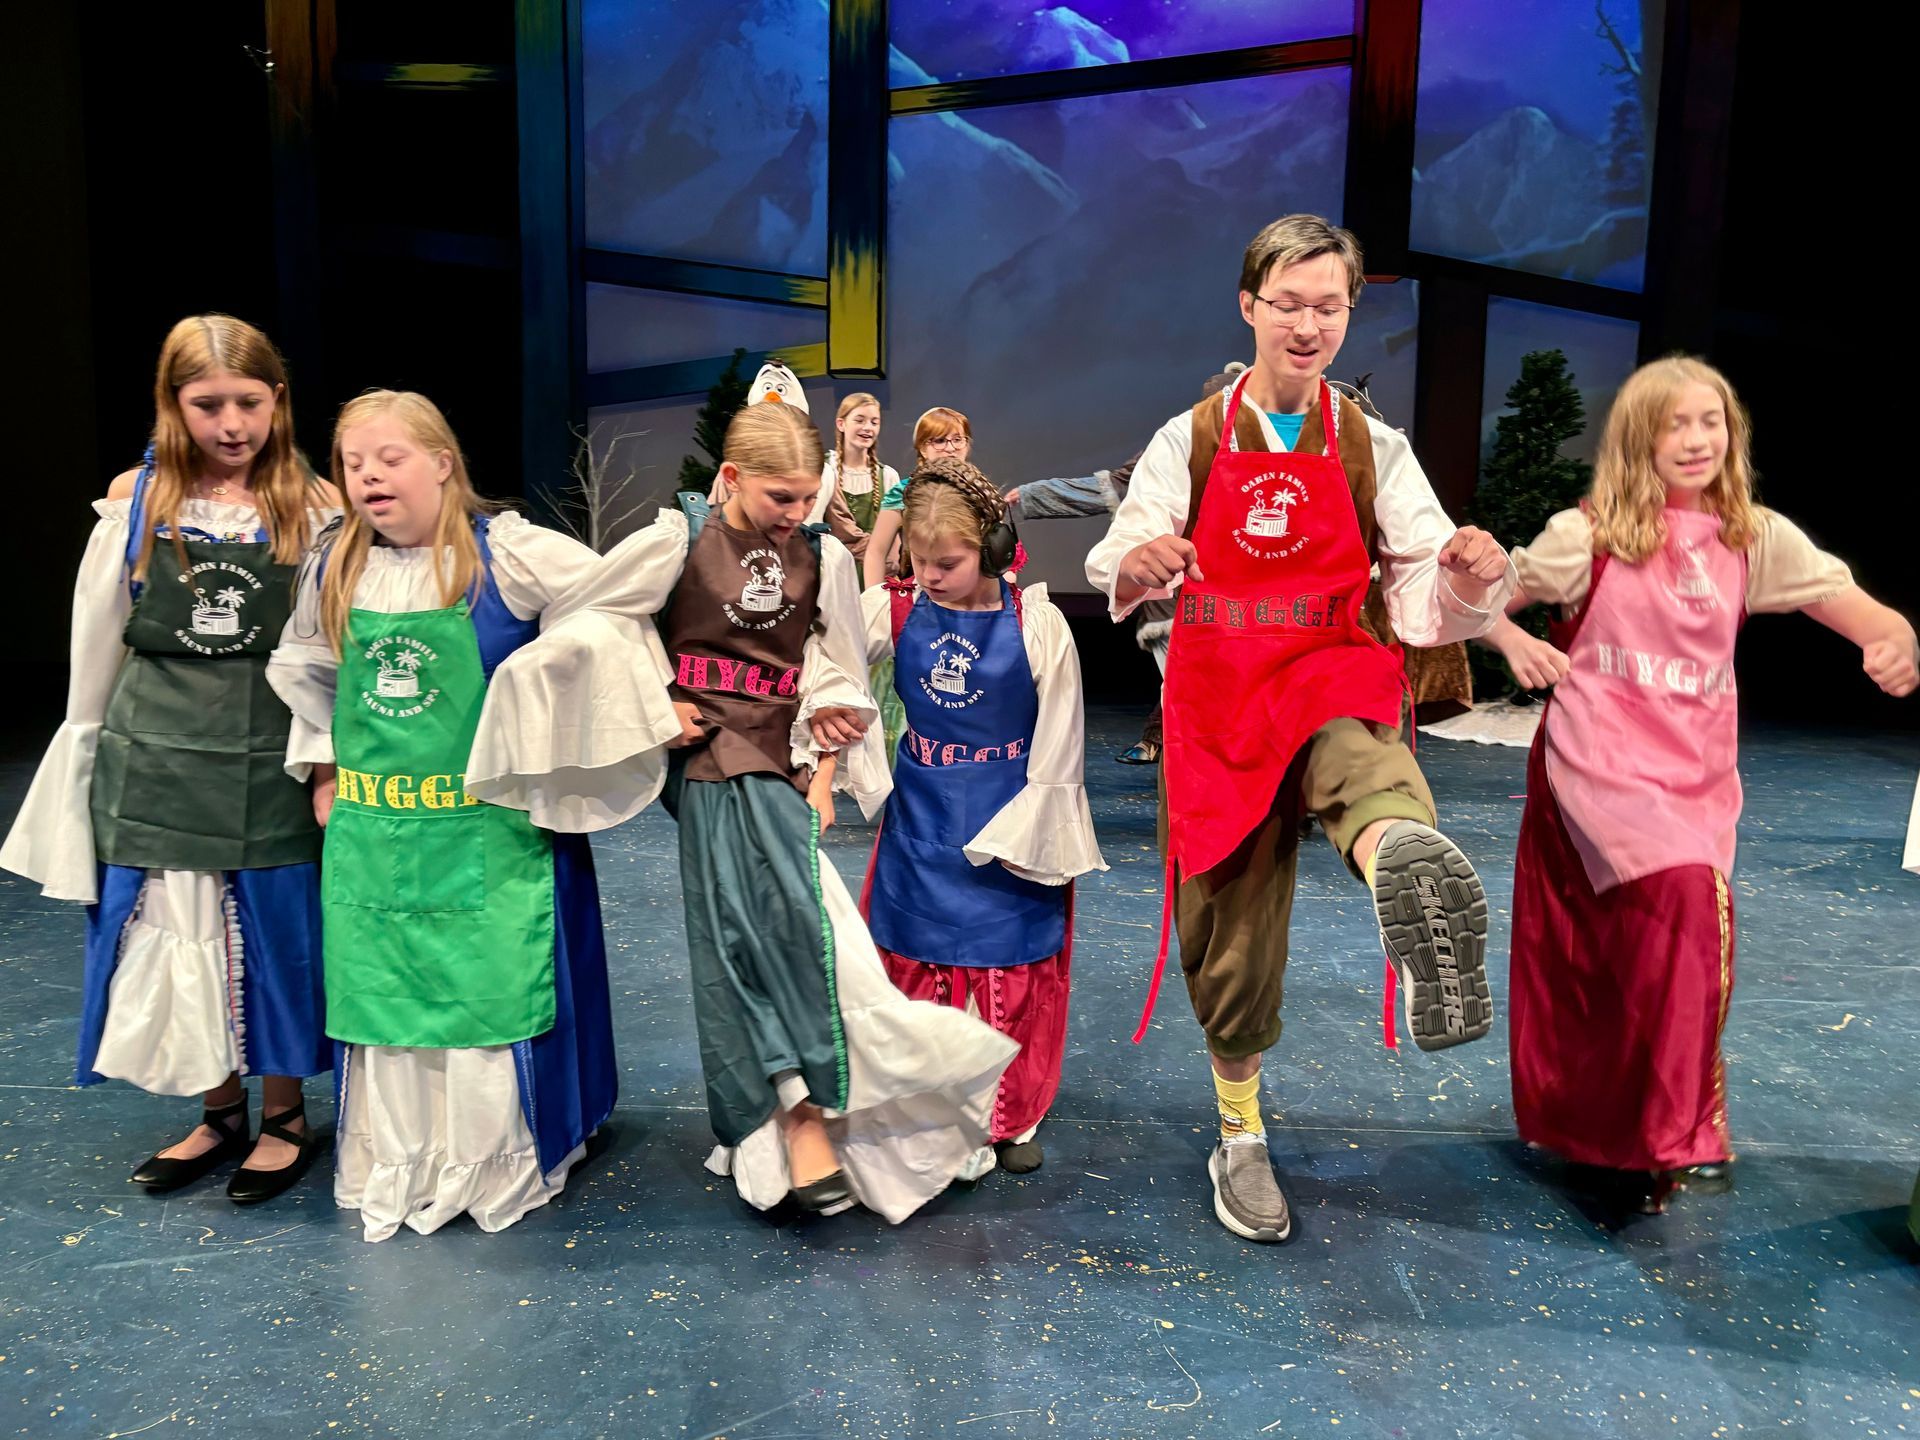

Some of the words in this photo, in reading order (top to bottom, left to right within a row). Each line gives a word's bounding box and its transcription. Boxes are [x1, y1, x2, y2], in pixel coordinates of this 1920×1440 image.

[1241, 472, 1275, 493] OAKEN
[1279, 472, 1309, 502] FAMILY
[1264, 550, 1287, 559] AND
[1291, 536, 1310, 553] SPA
[220, 562, 263, 589] FAMILY
[753, 620, 776, 629] AND
[778, 604, 796, 620] SPA
[174, 629, 212, 655] SAUNA
[217, 643, 243, 653] AND
[243, 626, 262, 644] SPA
[364, 637, 393, 659] OAKEN
[396, 636, 438, 661] FAMILY
[952, 633, 981, 659] FAMILY
[362, 691, 394, 716] SAUNA
[397, 705, 423, 717] AND
[422, 689, 440, 707] SPA
[919, 677, 942, 705] SAUNA
[967, 689, 984, 704] SPA
[1411, 875, 1466, 1037] SKECHERS
